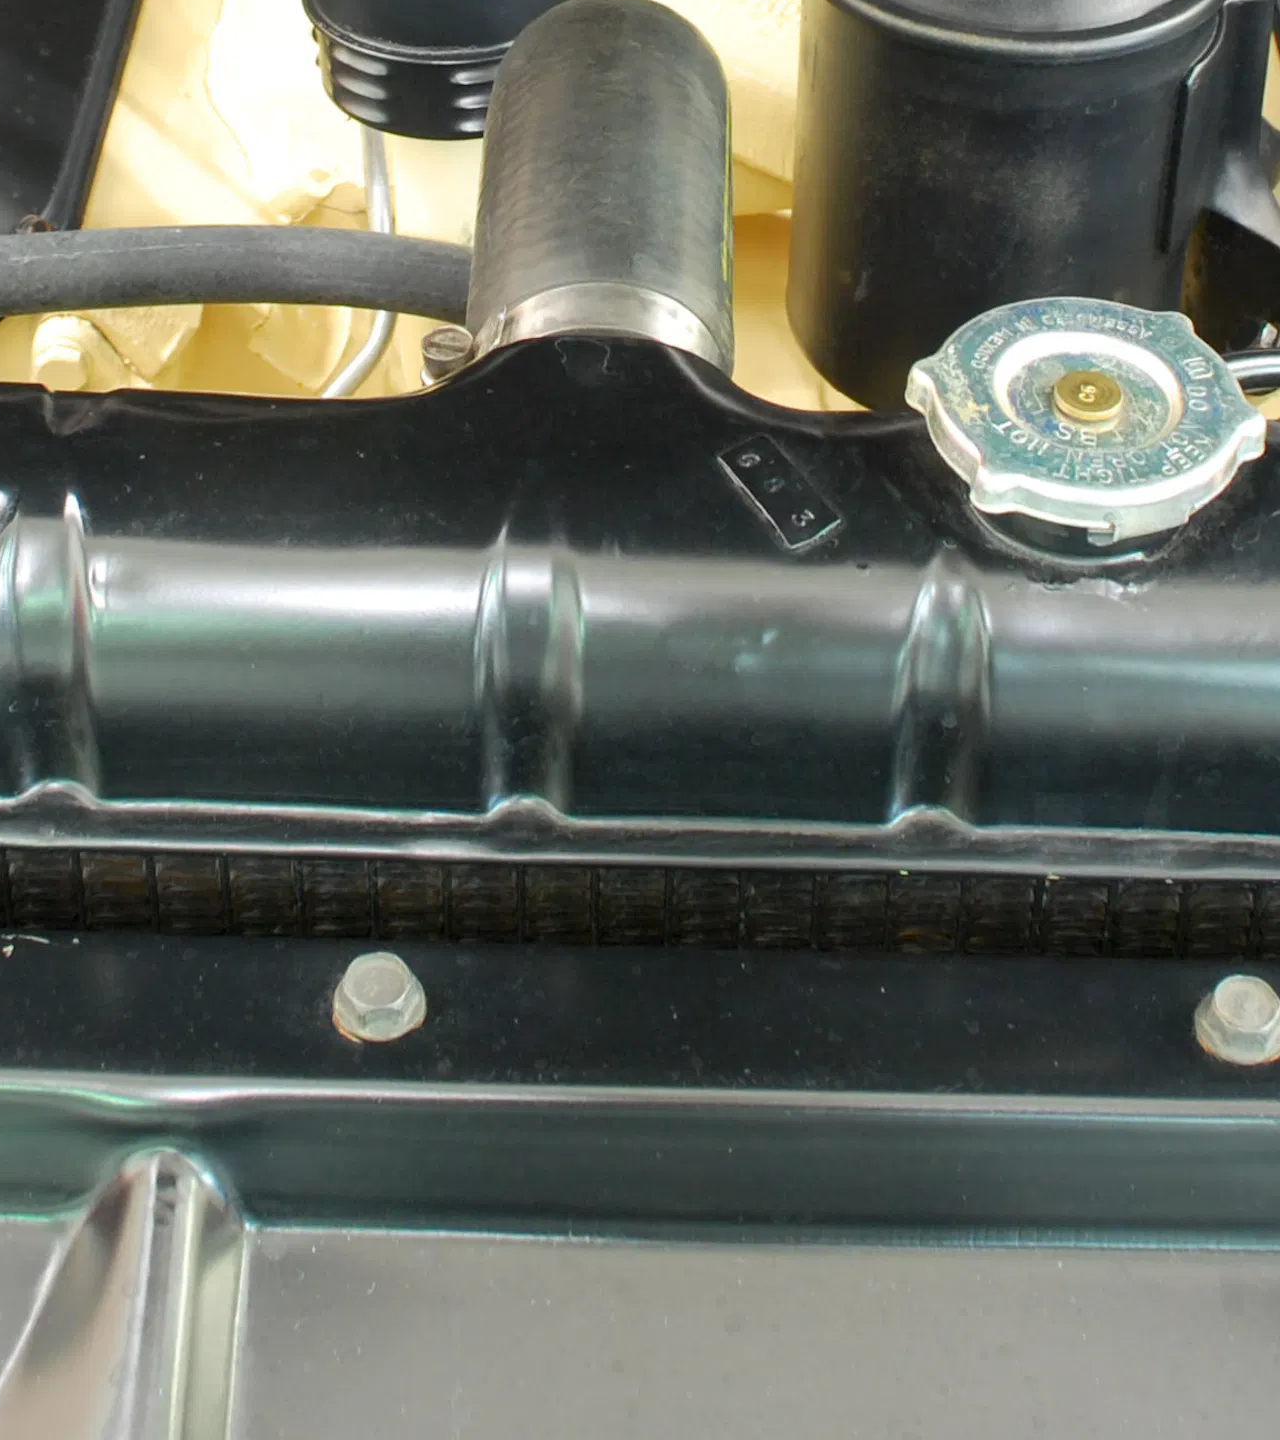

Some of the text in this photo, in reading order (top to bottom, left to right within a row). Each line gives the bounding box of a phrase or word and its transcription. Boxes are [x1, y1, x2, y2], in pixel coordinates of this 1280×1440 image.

[1185, 385, 1209, 411] DO
[1051, 436, 1214, 485] KEEP TIGHT
